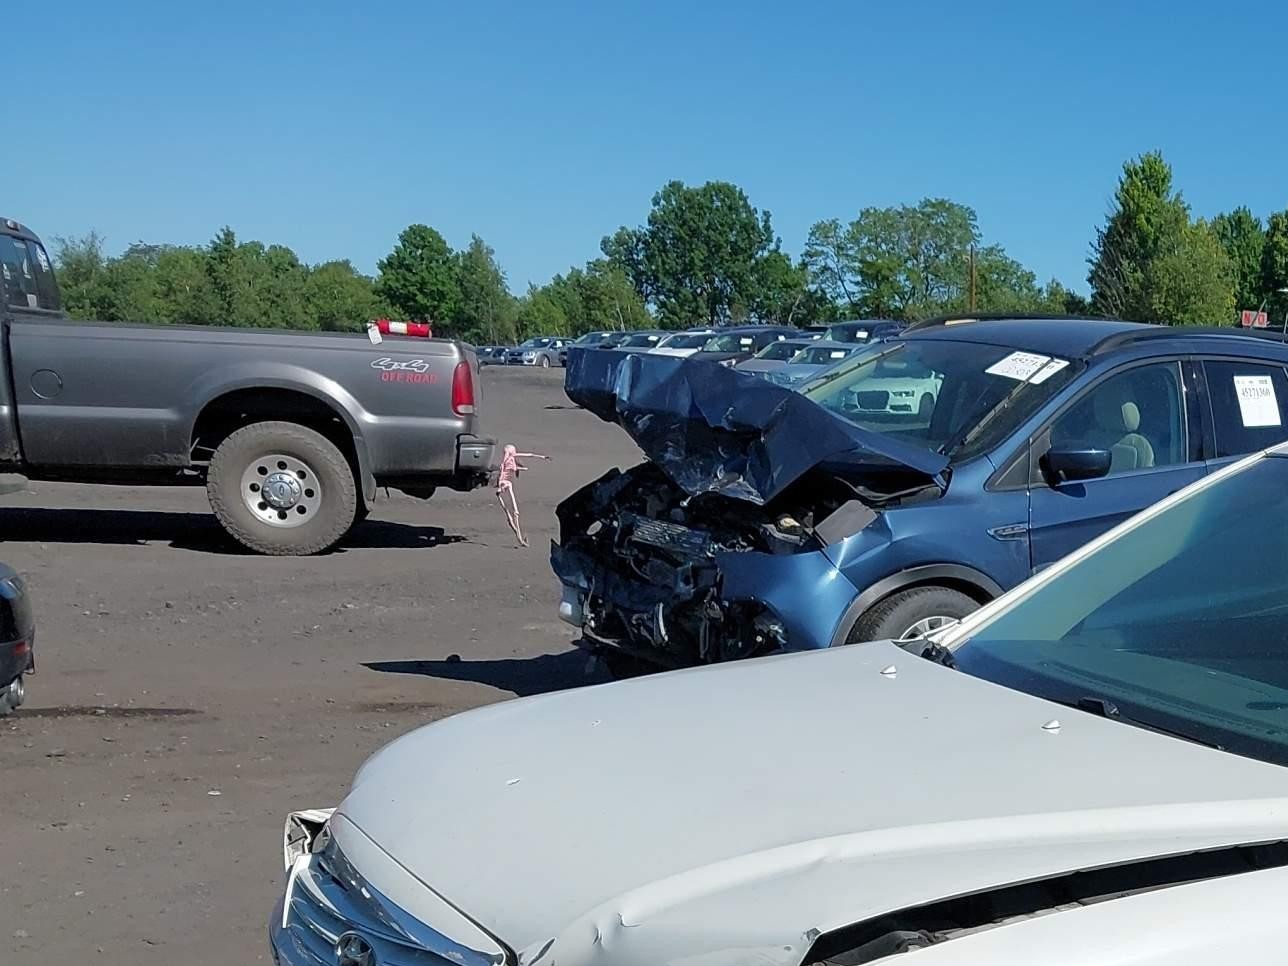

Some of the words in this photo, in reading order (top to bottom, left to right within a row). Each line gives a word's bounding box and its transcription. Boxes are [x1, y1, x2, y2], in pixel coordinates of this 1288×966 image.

[370, 357, 430, 373] 4x4
[381, 372, 400, 382] OFF
[406, 373, 438, 384] ROAD
